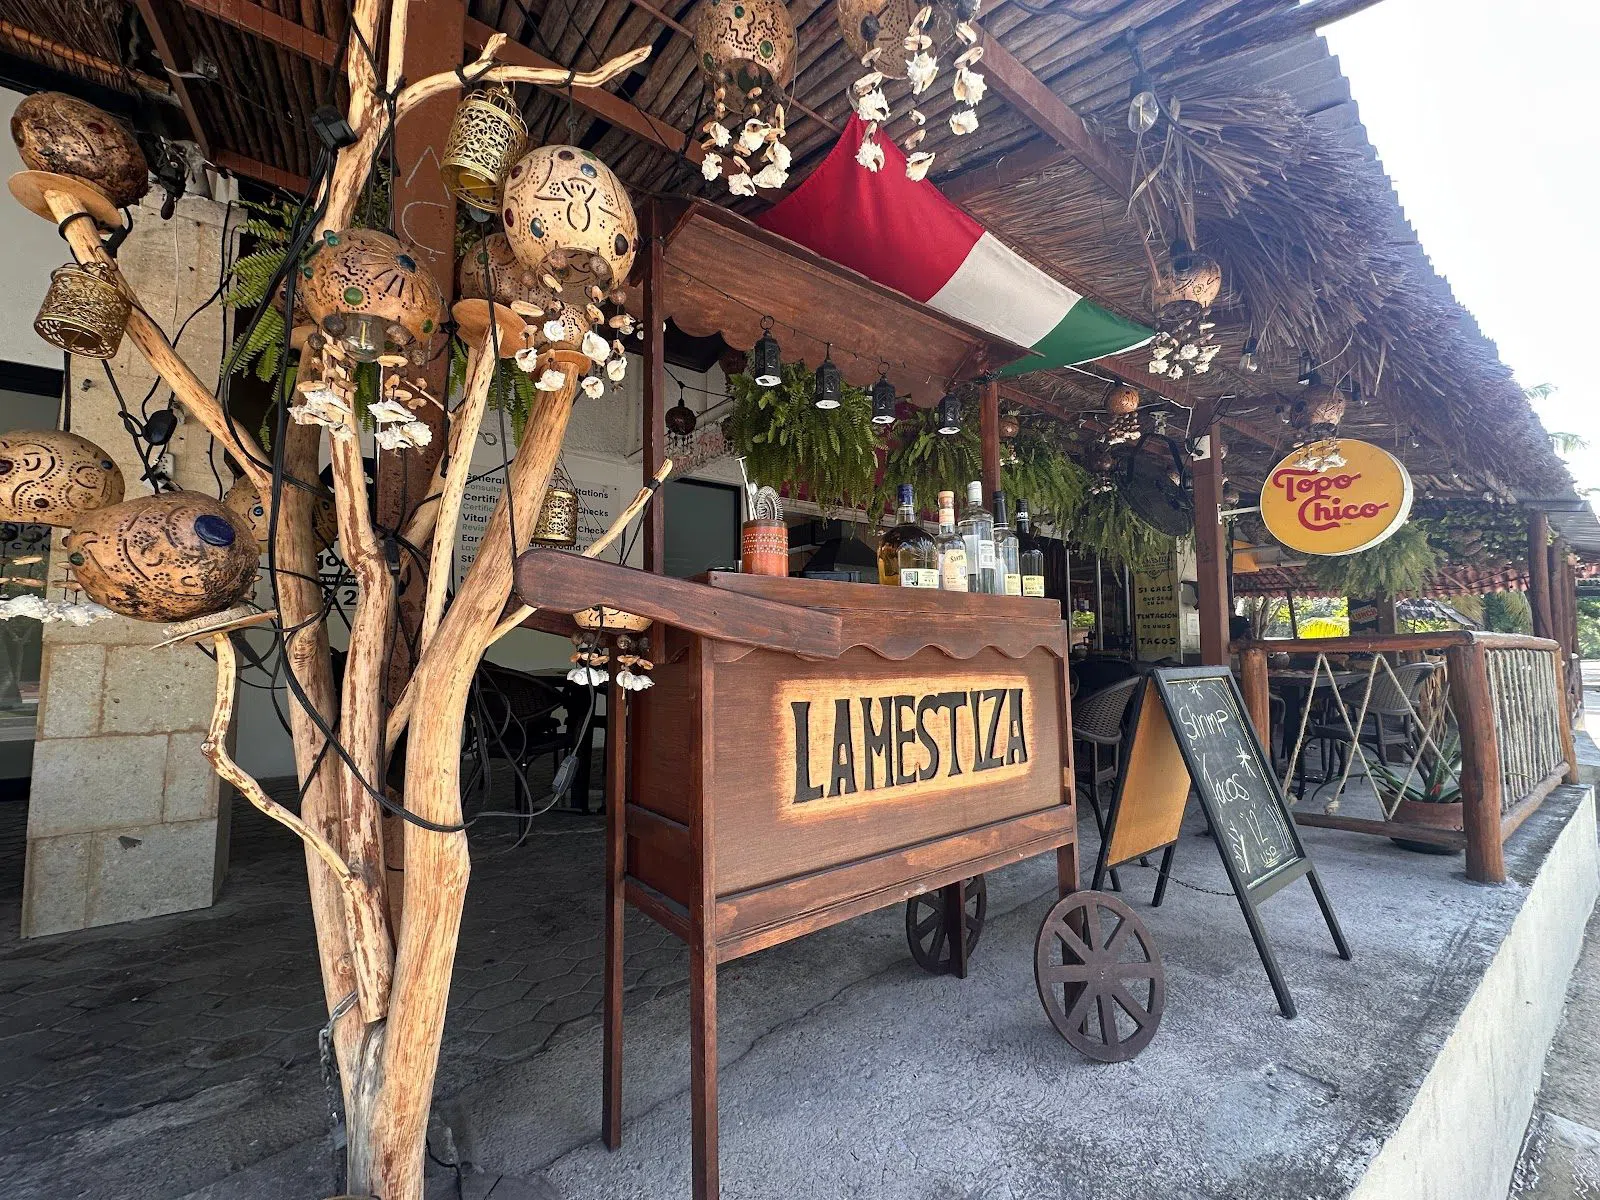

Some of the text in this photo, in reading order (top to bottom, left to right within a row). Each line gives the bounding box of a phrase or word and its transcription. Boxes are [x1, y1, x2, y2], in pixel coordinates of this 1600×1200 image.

[1272, 467, 1362, 503] Topo
[462, 513, 488, 523] Vital
[1297, 494, 1390, 532] Chico
[461, 534, 479, 543] Ear
[1150, 585, 1173, 593] CAES
[1139, 637, 1177, 645] TACOS
[1178, 703, 1229, 741] Shrimp
[1259, 845, 1278, 865] USD
